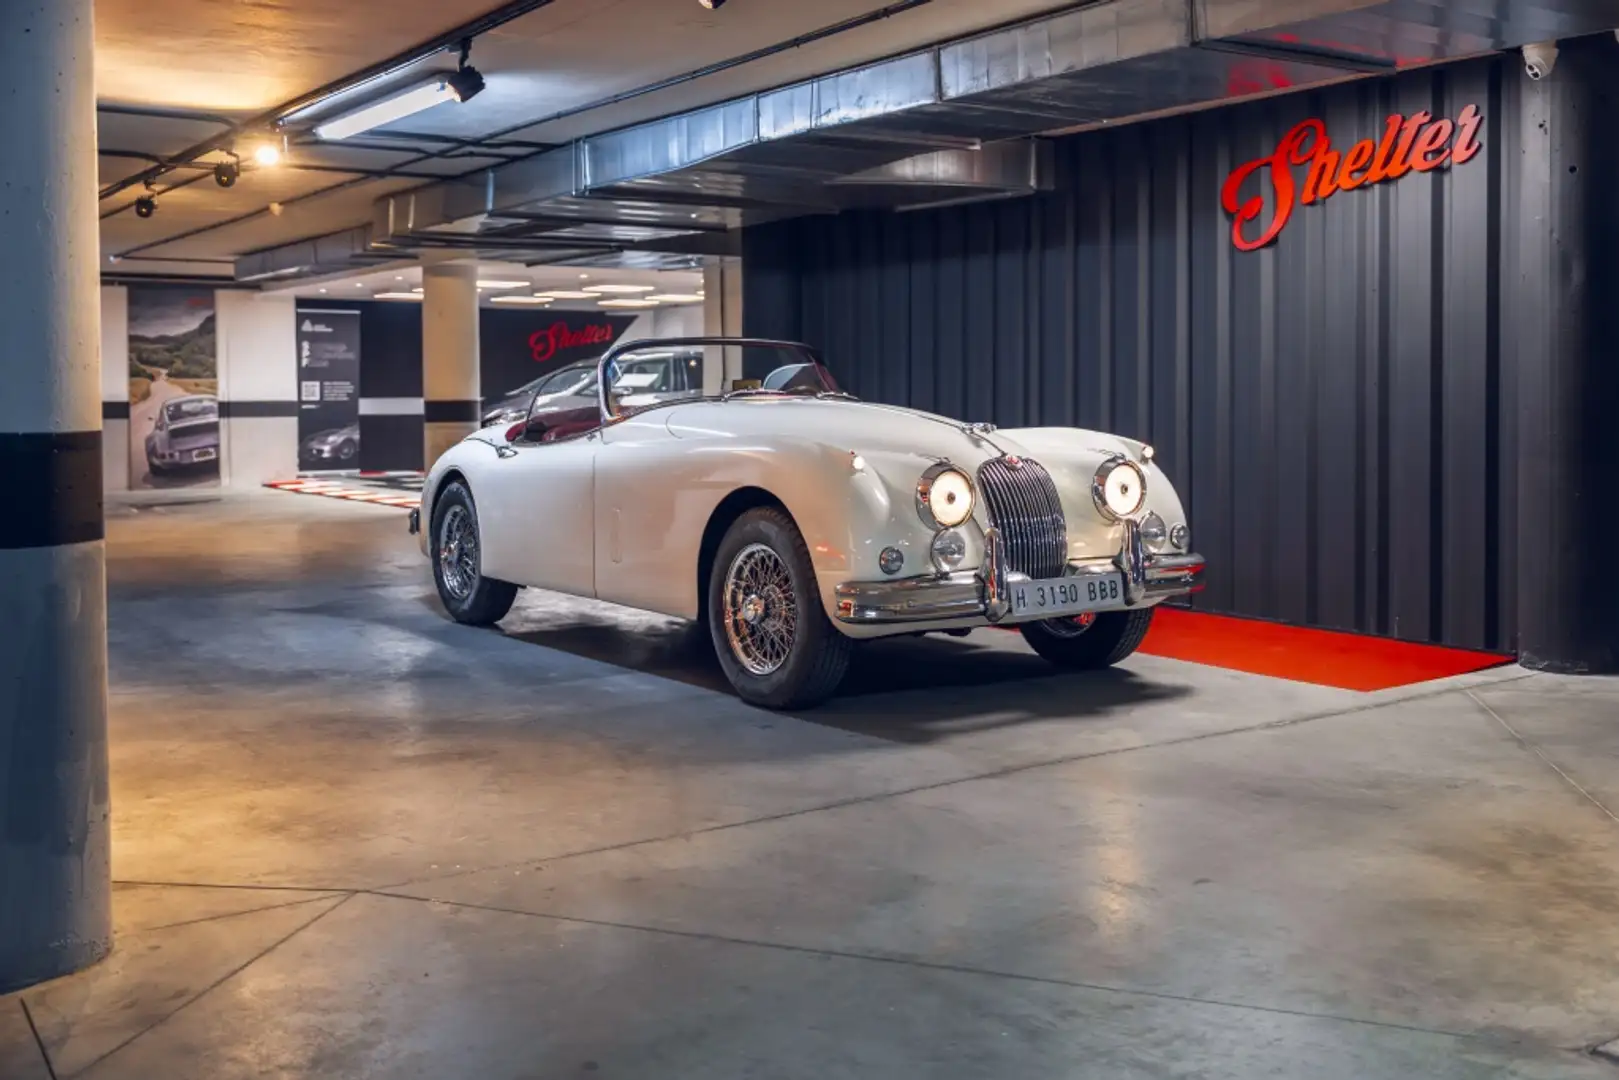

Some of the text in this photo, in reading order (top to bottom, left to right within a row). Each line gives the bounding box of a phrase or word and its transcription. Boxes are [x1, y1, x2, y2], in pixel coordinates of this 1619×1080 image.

[1221, 104, 1483, 251] Shelter
[1015, 580, 1119, 609] H 3190 BBB
